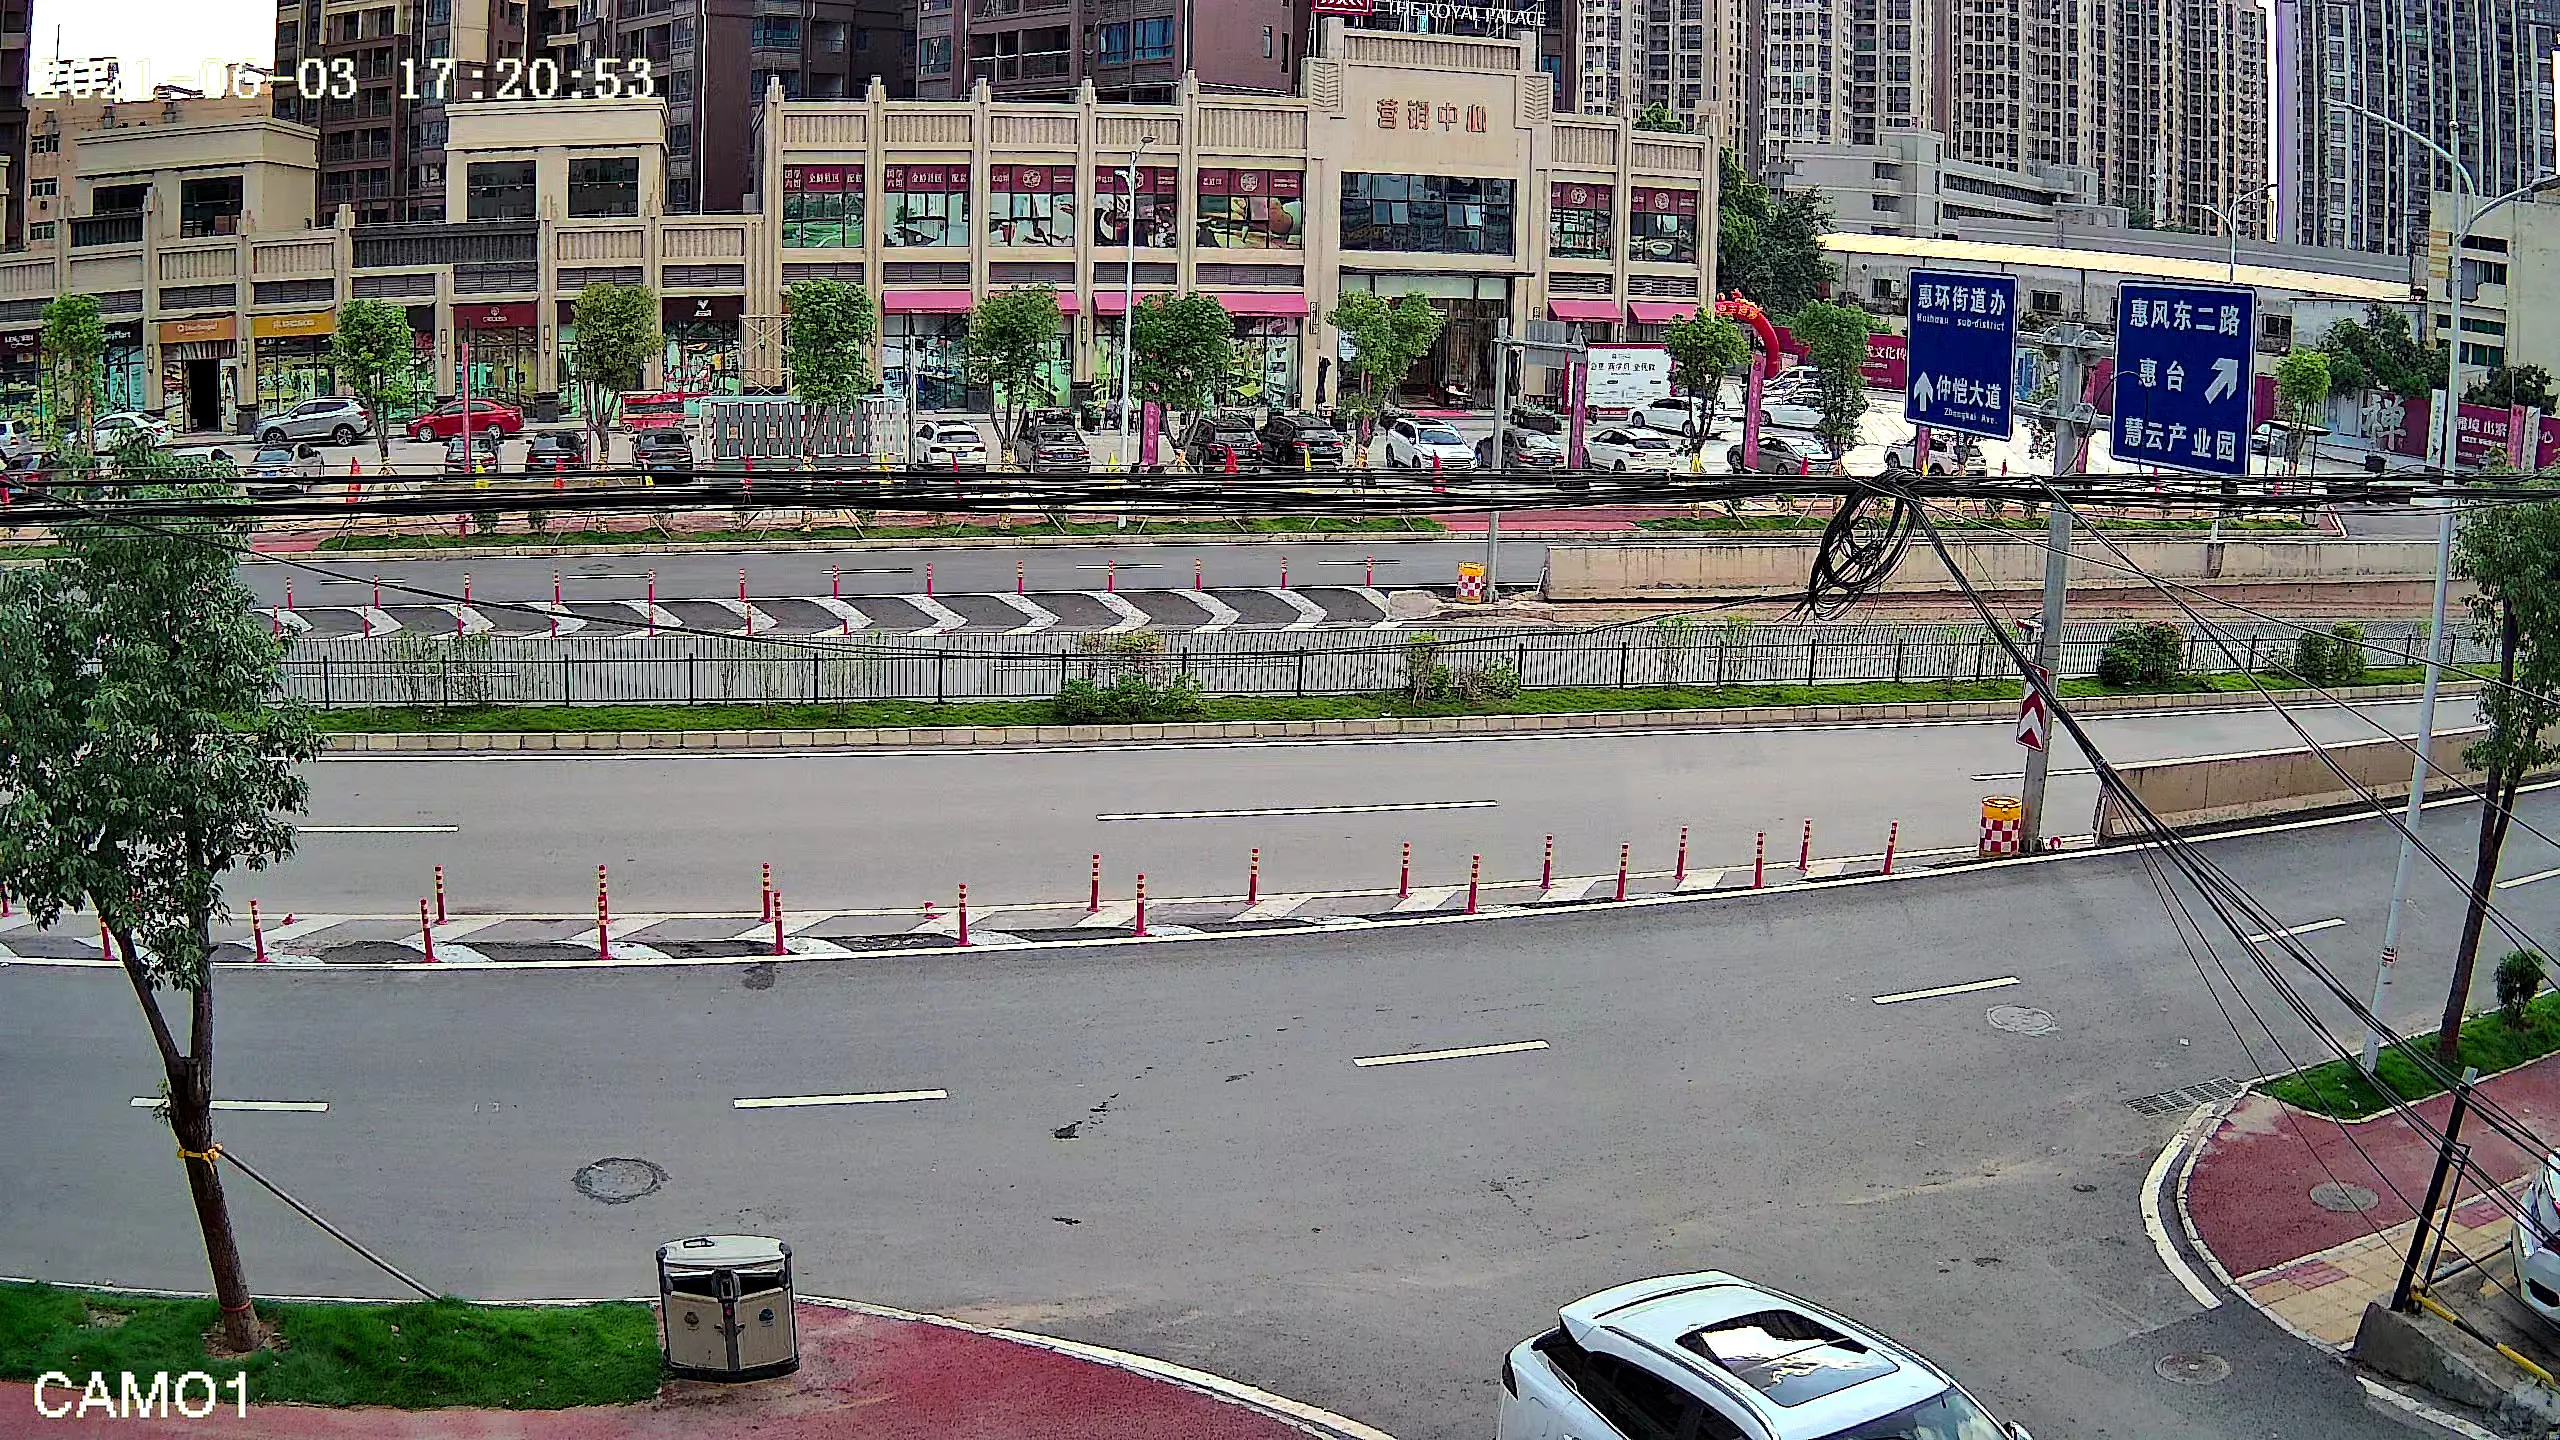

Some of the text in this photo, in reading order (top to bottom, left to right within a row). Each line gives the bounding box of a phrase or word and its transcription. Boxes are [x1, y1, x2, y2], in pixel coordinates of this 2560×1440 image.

[1425, 3, 1480, 22] ROYAL
[1487, 9, 1547, 26] PALACE
[1376, 98, 1487, 133] 营销中心
[1917, 283, 2006, 316] 惠环街道办
[1956, 318, 2005, 331] sub-district
[2130, 298, 2241, 337] 惠风东二路
[1936, 374, 2002, 410] 仲恺大道
[2138, 357, 2185, 392] 惠台
[2124, 416, 2236, 463] 慧云产业园
